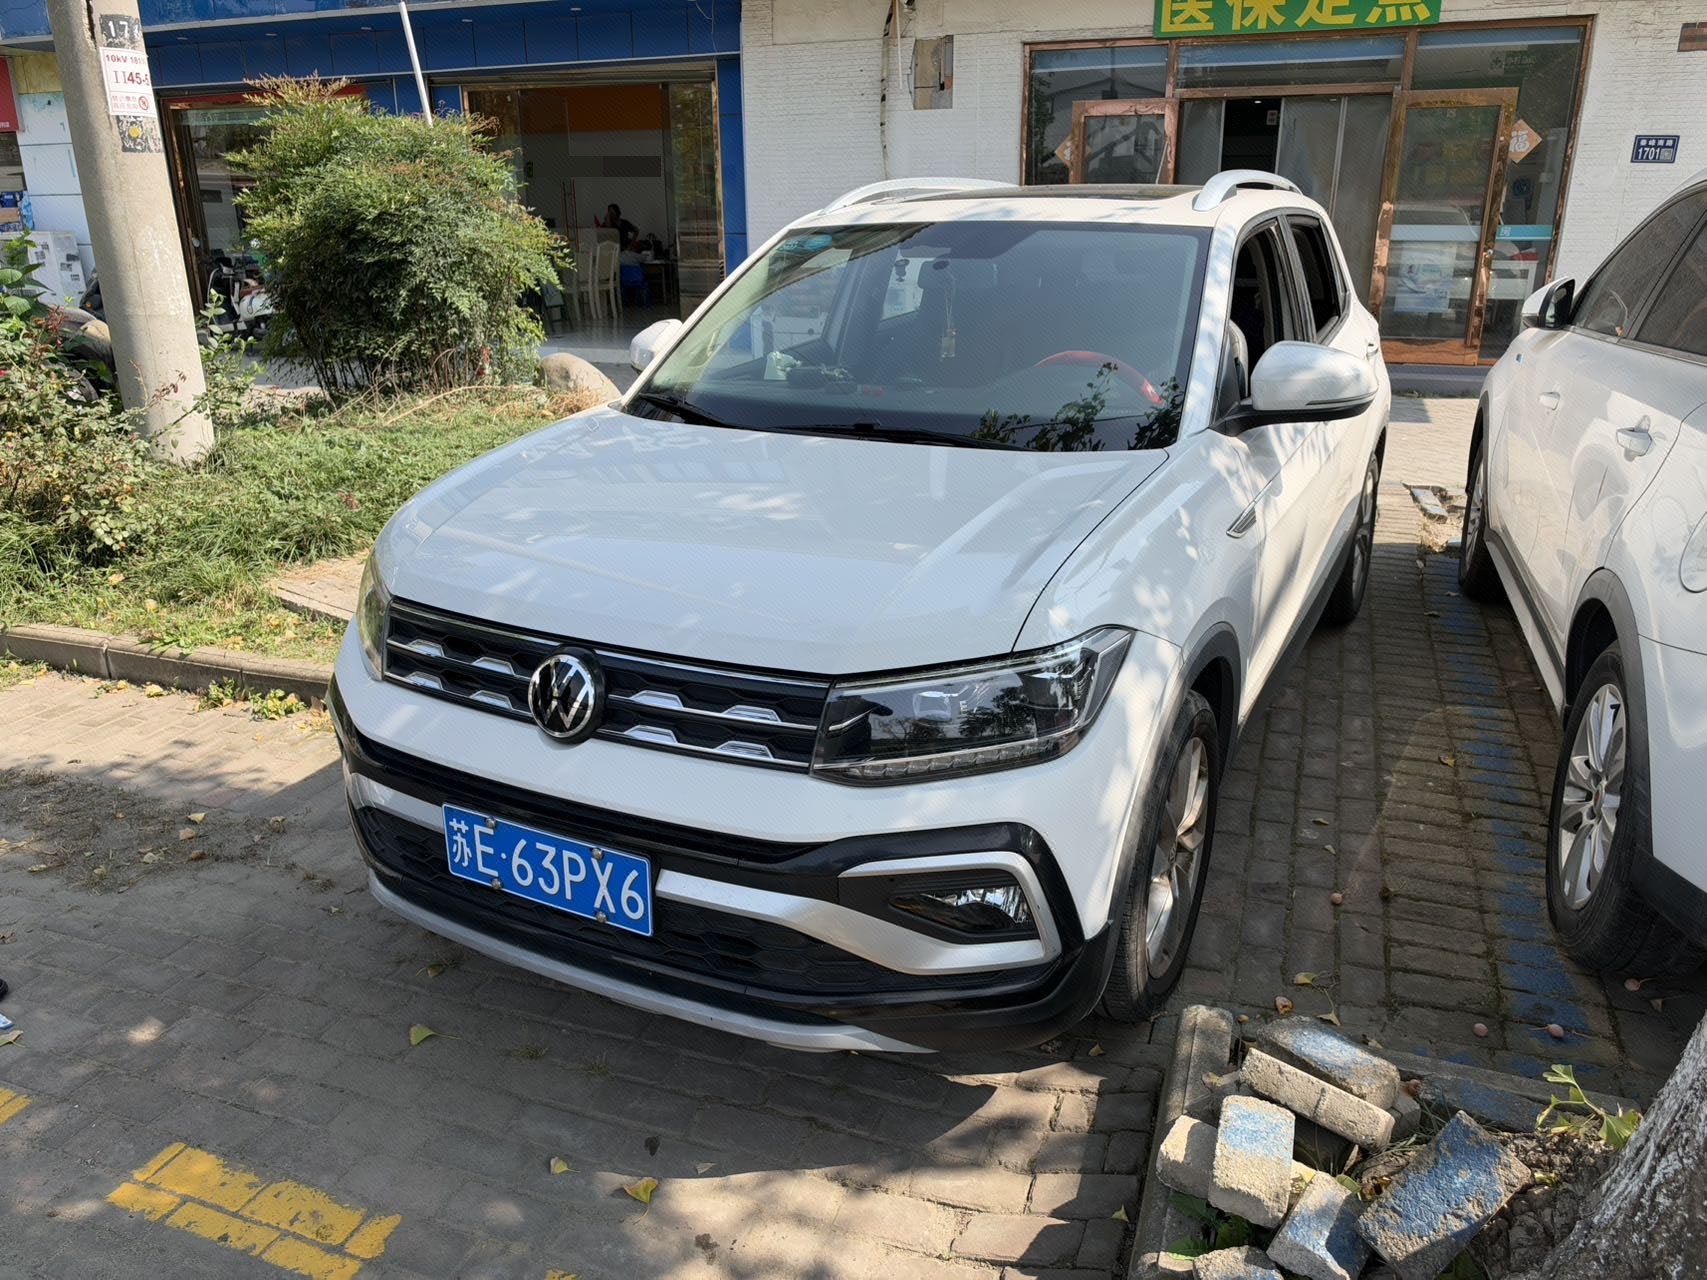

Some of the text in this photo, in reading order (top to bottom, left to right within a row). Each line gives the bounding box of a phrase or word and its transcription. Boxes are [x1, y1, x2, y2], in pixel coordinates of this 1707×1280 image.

[106, 54, 147, 65] 10kV 181
[1508, 130, 1531, 153] 福
[1638, 147, 1660, 160] 1701
